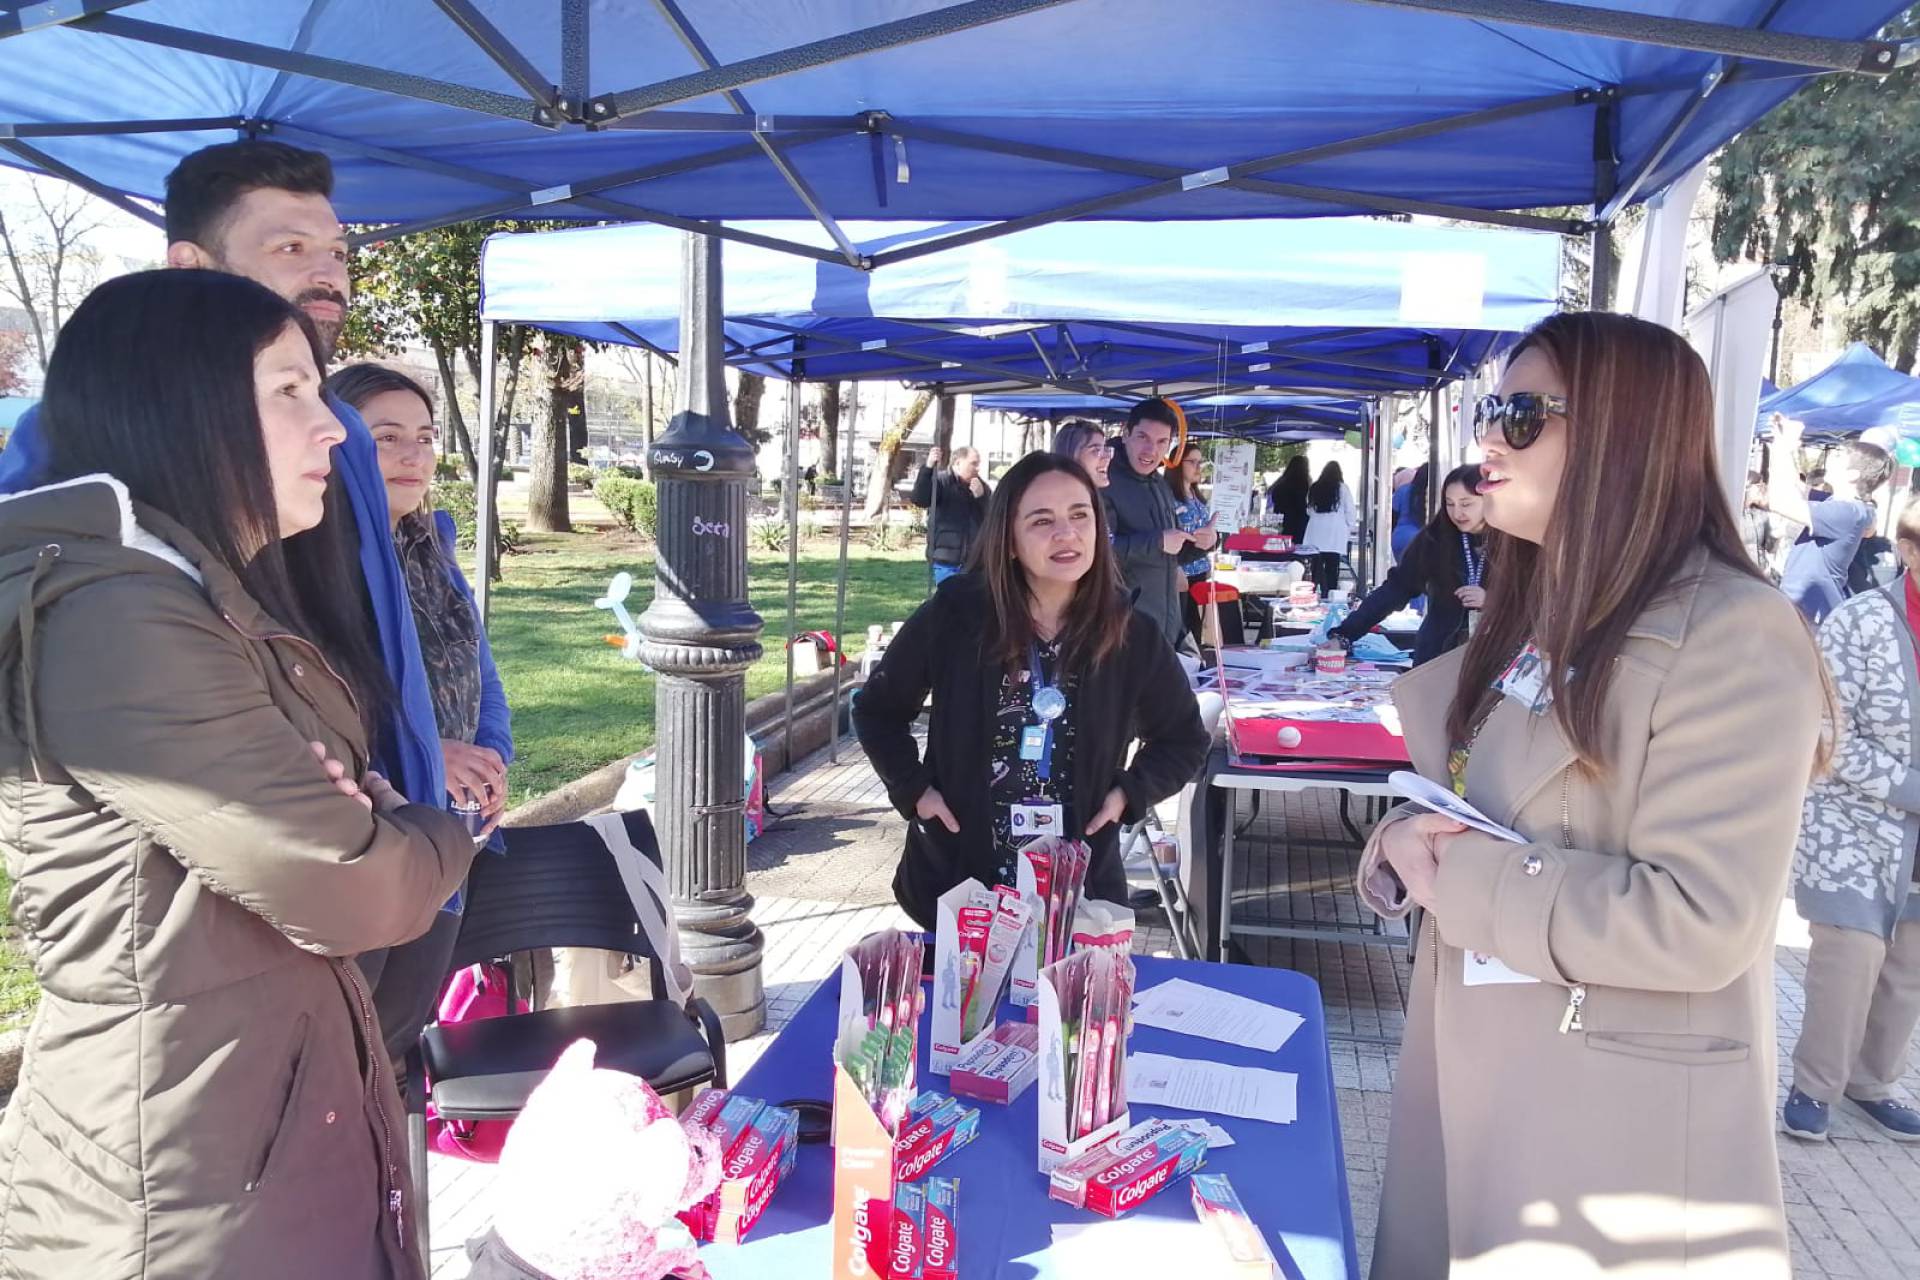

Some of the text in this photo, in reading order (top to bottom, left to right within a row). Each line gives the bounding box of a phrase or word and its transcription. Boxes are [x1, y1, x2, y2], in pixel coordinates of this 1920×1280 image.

[896, 1124, 931, 1151] gate
[722, 1136, 763, 1181] Colgate
[898, 1140, 944, 1180] Colgate
[1097, 1148, 1155, 1184] Colgate
[1118, 1166, 1168, 1206] Colgate
[892, 1222, 916, 1273] Colgate
[926, 1217, 949, 1267] Colgate
